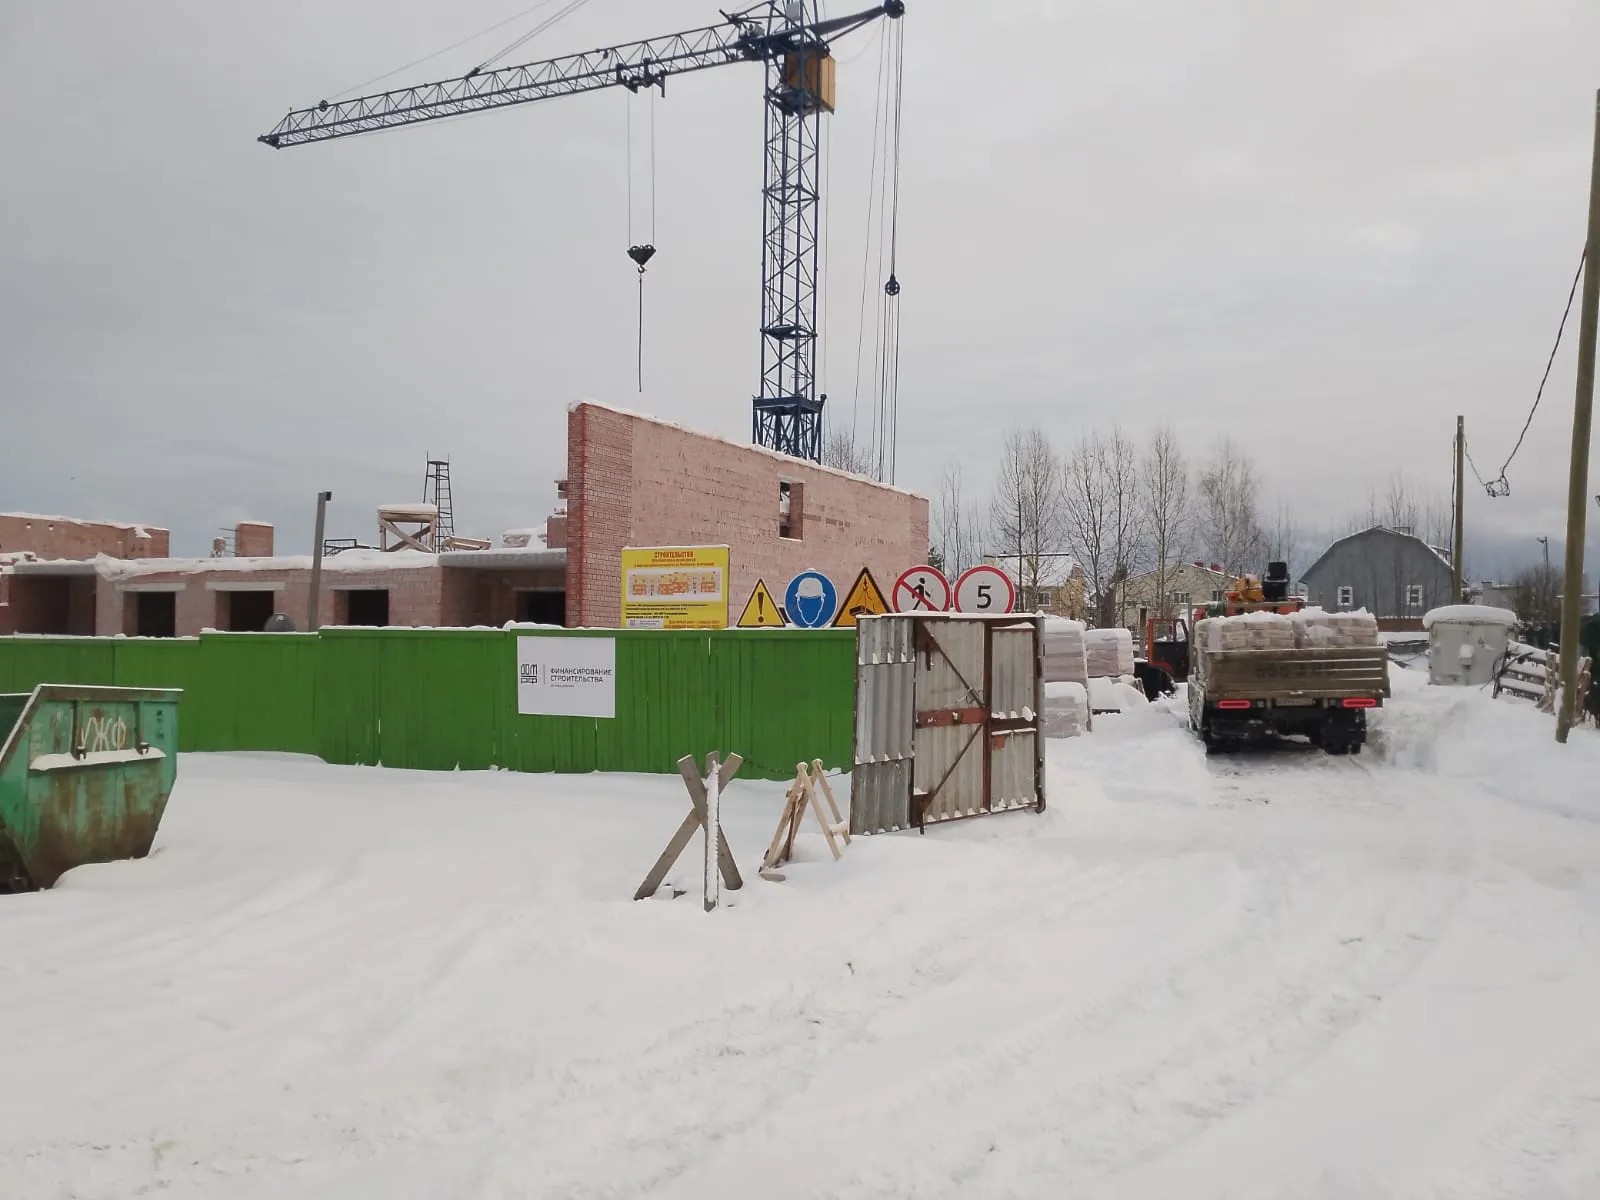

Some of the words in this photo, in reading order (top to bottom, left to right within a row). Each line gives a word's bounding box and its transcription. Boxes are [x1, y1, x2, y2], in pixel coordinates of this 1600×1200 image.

[976, 585, 992, 609] 5
[521, 664, 538, 675] ДОМ
[550, 668, 612, 676] ФИНАНСИРОВАНИЕ
[550, 675, 603, 683] СТРОИТЕЛЬСТВА
